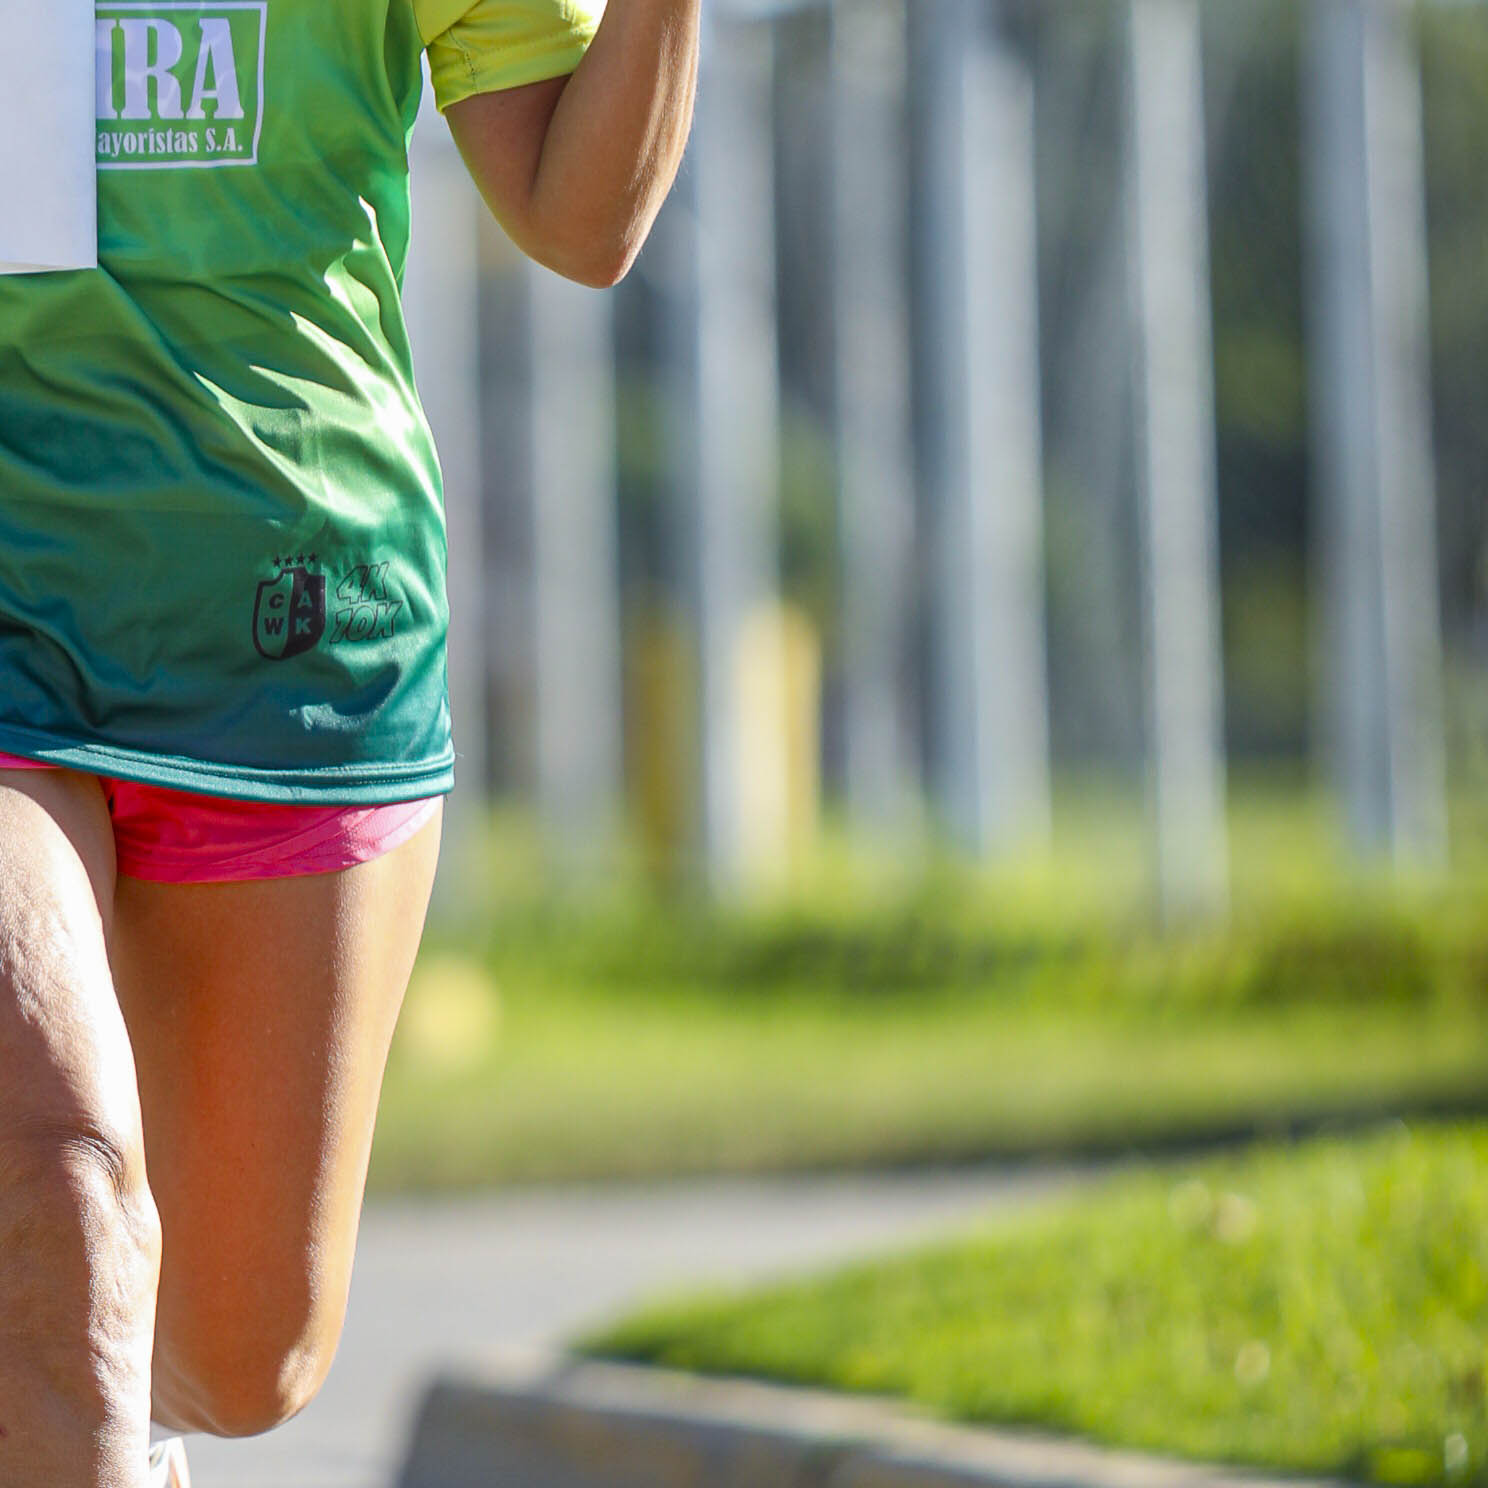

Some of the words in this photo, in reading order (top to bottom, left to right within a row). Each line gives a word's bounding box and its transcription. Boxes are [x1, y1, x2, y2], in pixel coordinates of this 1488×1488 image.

[96, 128, 198, 157] ayoristas
[206, 127, 243, 153] S.A.
[336, 561, 390, 605] 4K
[329, 600, 403, 644] 10K
